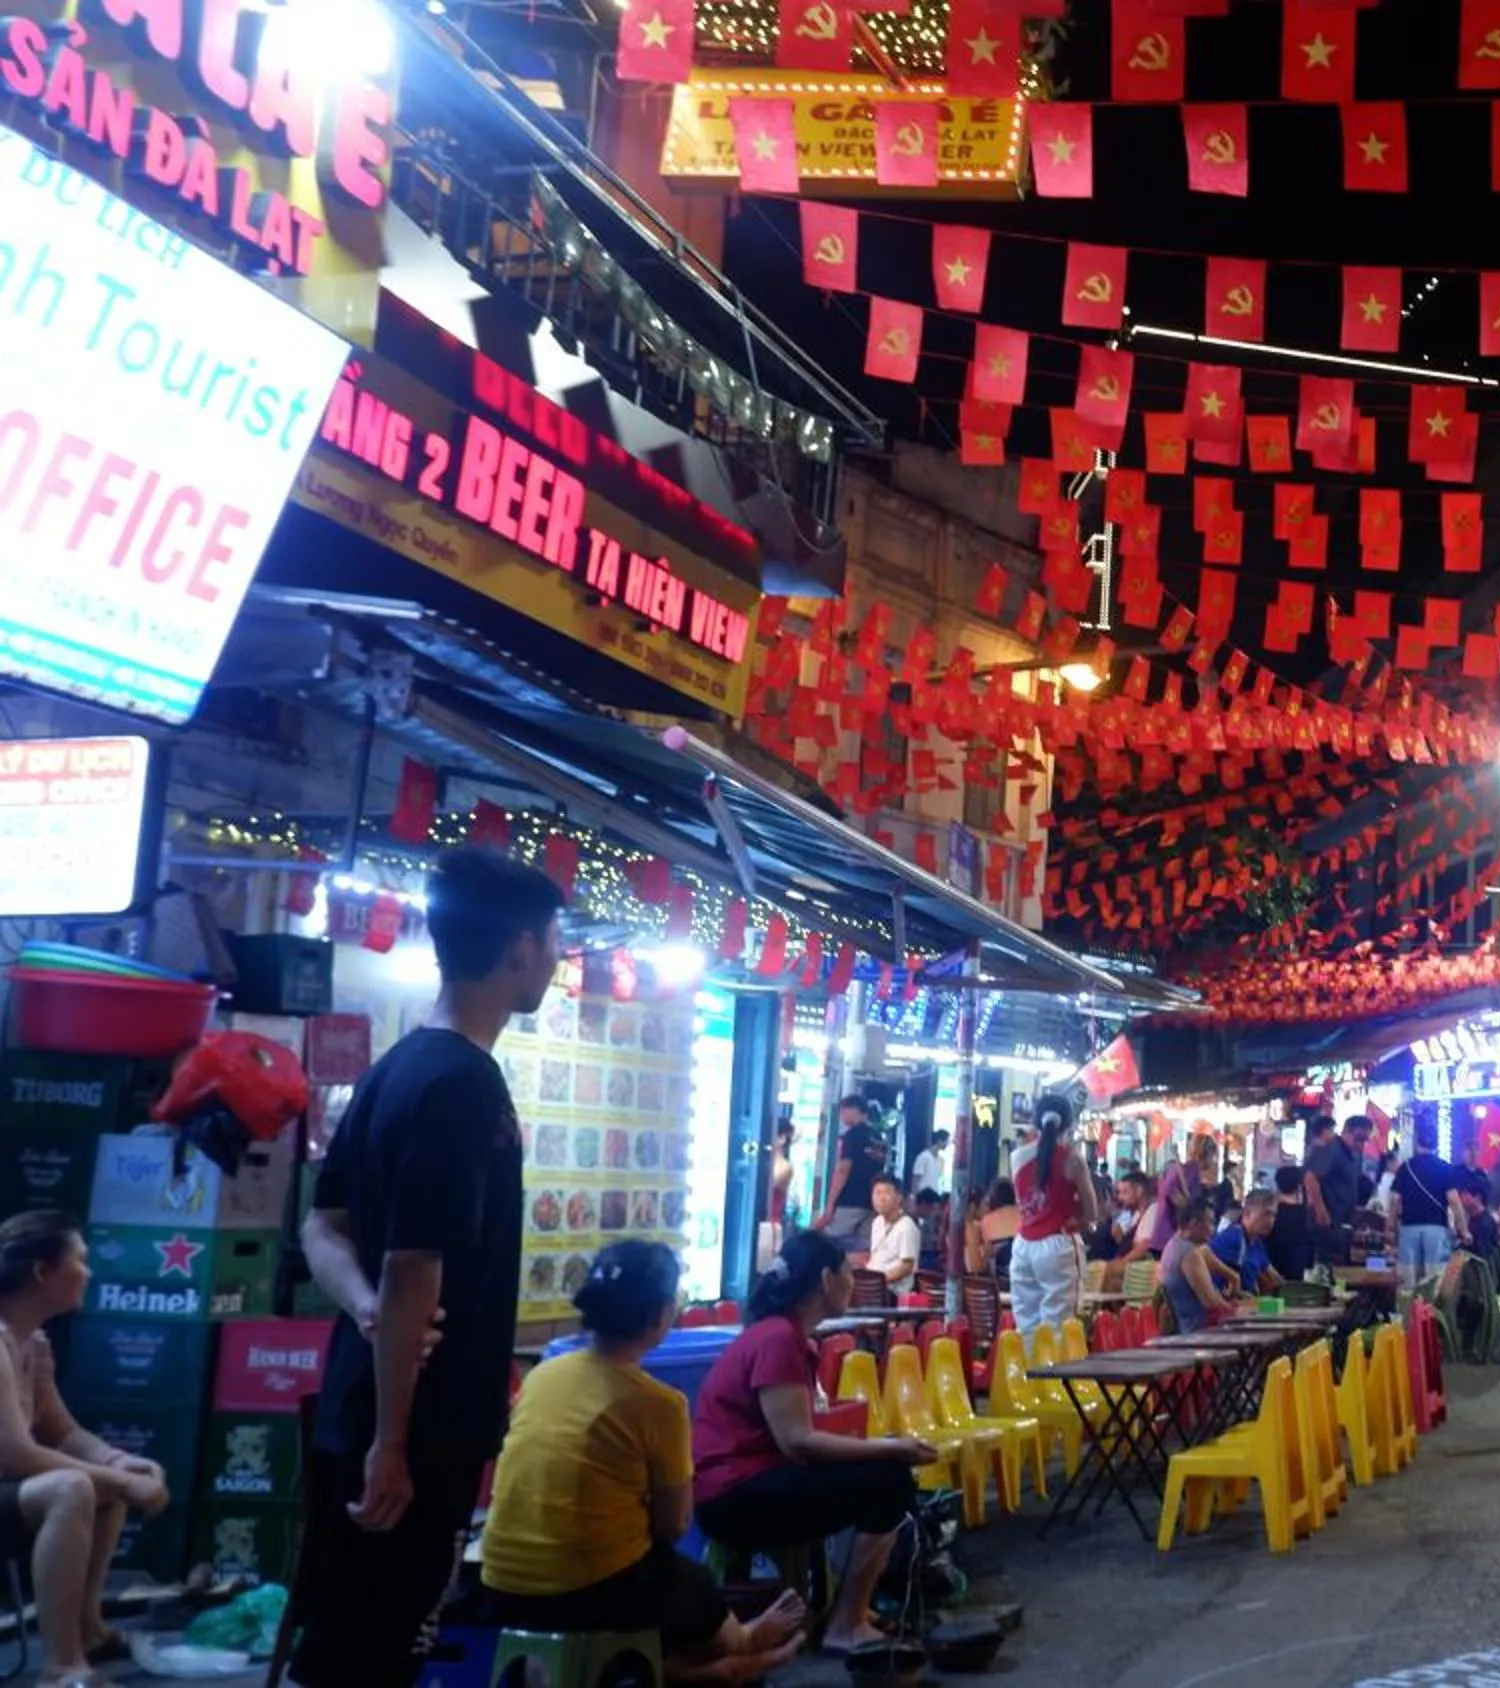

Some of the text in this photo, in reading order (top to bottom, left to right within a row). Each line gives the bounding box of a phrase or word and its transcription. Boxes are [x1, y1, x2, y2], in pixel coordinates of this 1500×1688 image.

[1, 17, 135, 158] SẢN
[145, 106, 218, 217] ĐÀ
[231, 167, 325, 277] LẠT
[85, 271, 309, 451] Tourist
[0, 409, 251, 603] OFFICE
[417, 432, 450, 501] 2
[454, 413, 586, 573] BEER
[690, 589, 750, 665] VIEW
[13, 1077, 104, 1108] TUBORG
